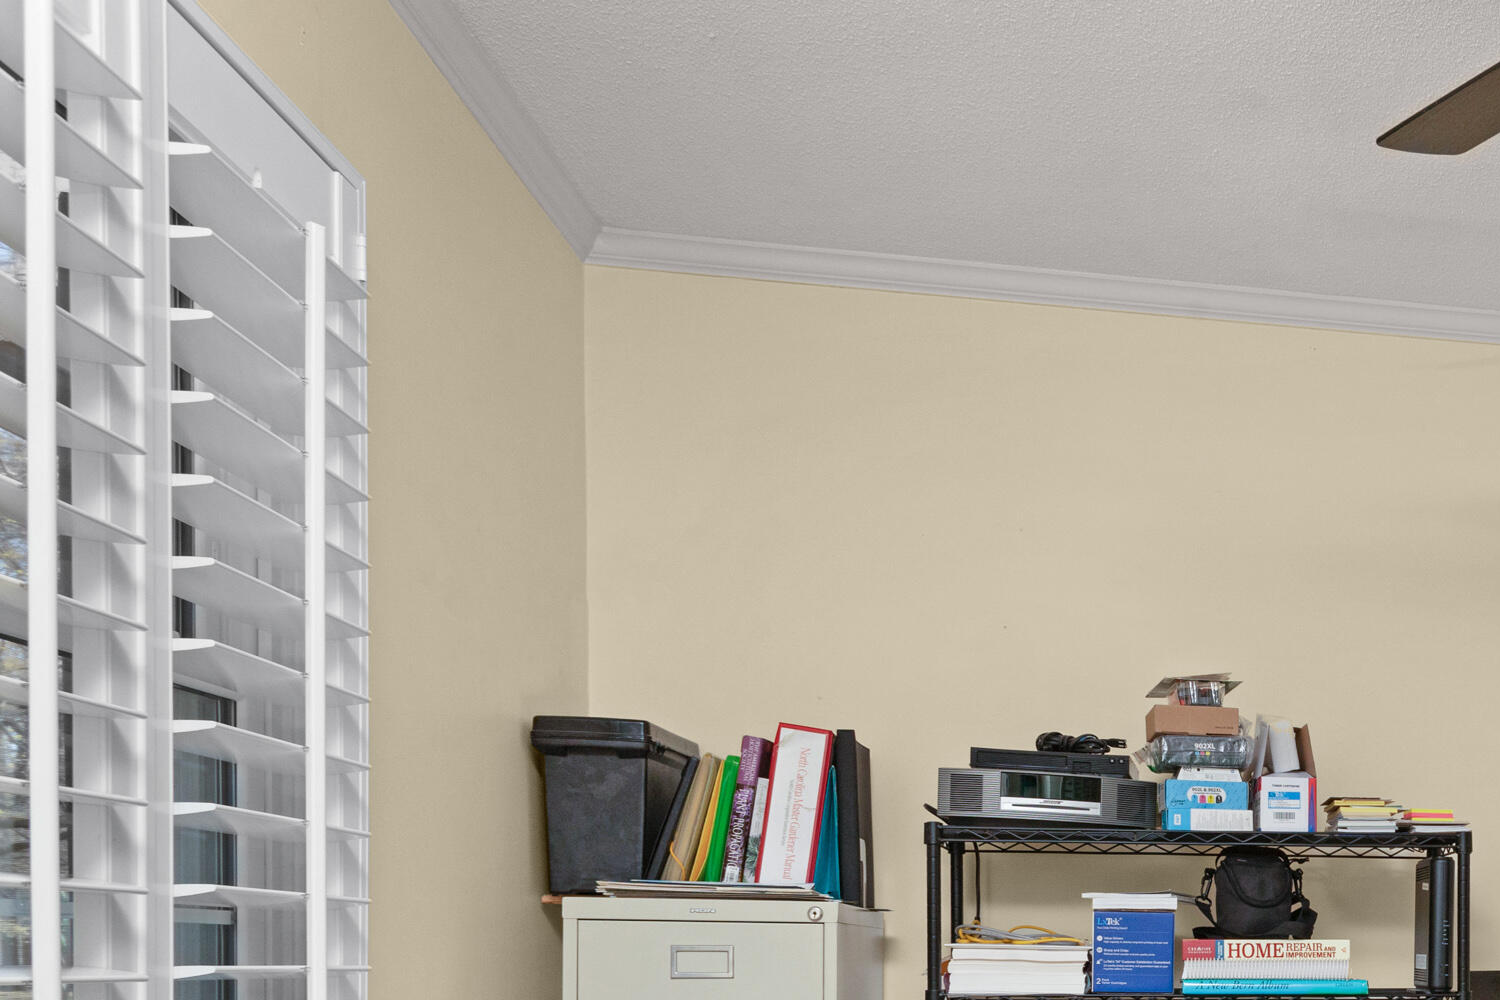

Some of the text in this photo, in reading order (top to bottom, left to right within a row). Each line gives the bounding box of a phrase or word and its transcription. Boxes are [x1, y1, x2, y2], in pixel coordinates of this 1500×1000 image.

[798, 746, 811, 767] North
[794, 769, 808, 797] Carolina
[727, 788, 751, 867] PLANT PROPAGATIO
[1097, 917, 1120, 926] LxTek
[1227, 943, 1284, 958] HOME
[1286, 943, 1323, 951] REPAIR
[1257, 980, 1289, 990] Album
